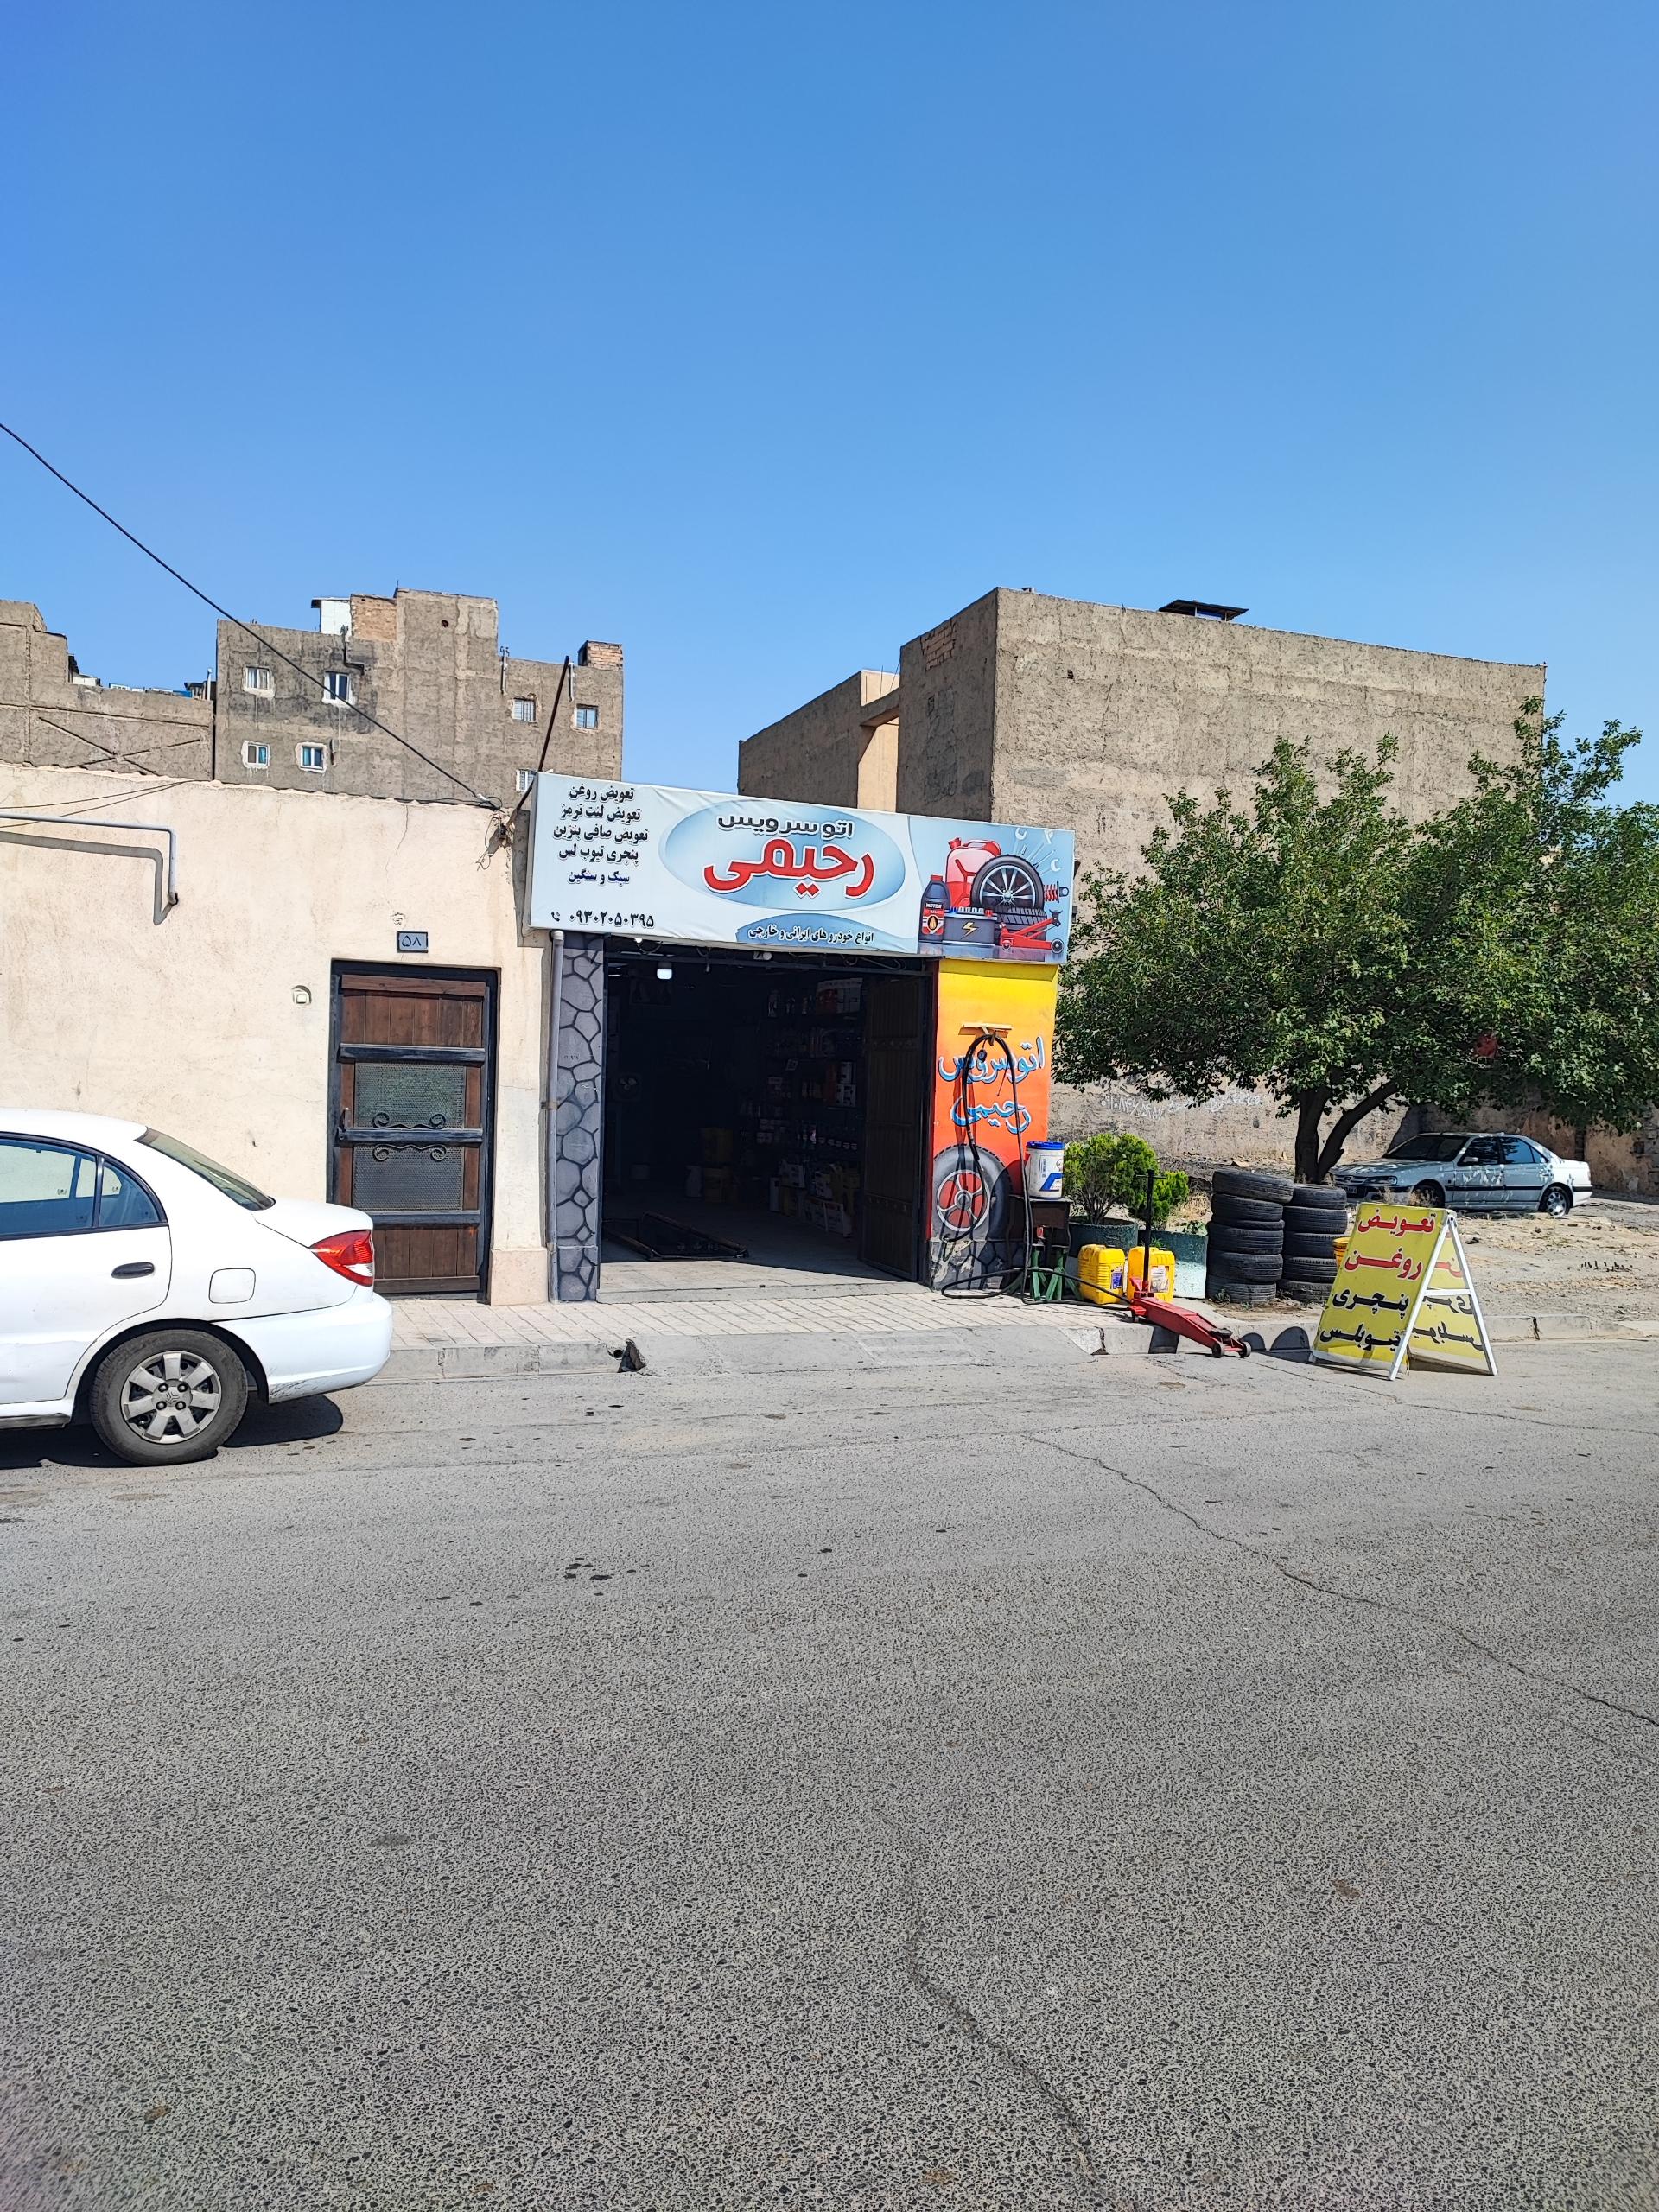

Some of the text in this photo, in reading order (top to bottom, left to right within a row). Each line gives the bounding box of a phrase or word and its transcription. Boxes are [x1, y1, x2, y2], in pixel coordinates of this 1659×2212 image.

[569, 783, 634, 803] تعویض روغن
[560, 804, 641, 823] تعویض لنت ترمز
[553, 823, 649, 844] تعویض صافی بنزین
[559, 843, 639, 865] پنچری تیوب لس
[704, 838, 874, 897] رحیمی
[568, 868, 630, 887] سبک و سنگین
[569, 910, 654, 928] ۰۹۳۰۲۰۵۰۳۹۵
[402, 935, 422, 947] ۵۸
[748, 925, 778, 939] خارجی
[779, 930, 785, 940] و
[785, 926, 810, 941] ایرانی
[855, 932, 874, 944] انواع
[1358, 1210, 1436, 1236] تعویض
[1344, 1247, 1422, 1281] روغن
[1332, 1289, 1409, 1319] پنچری
